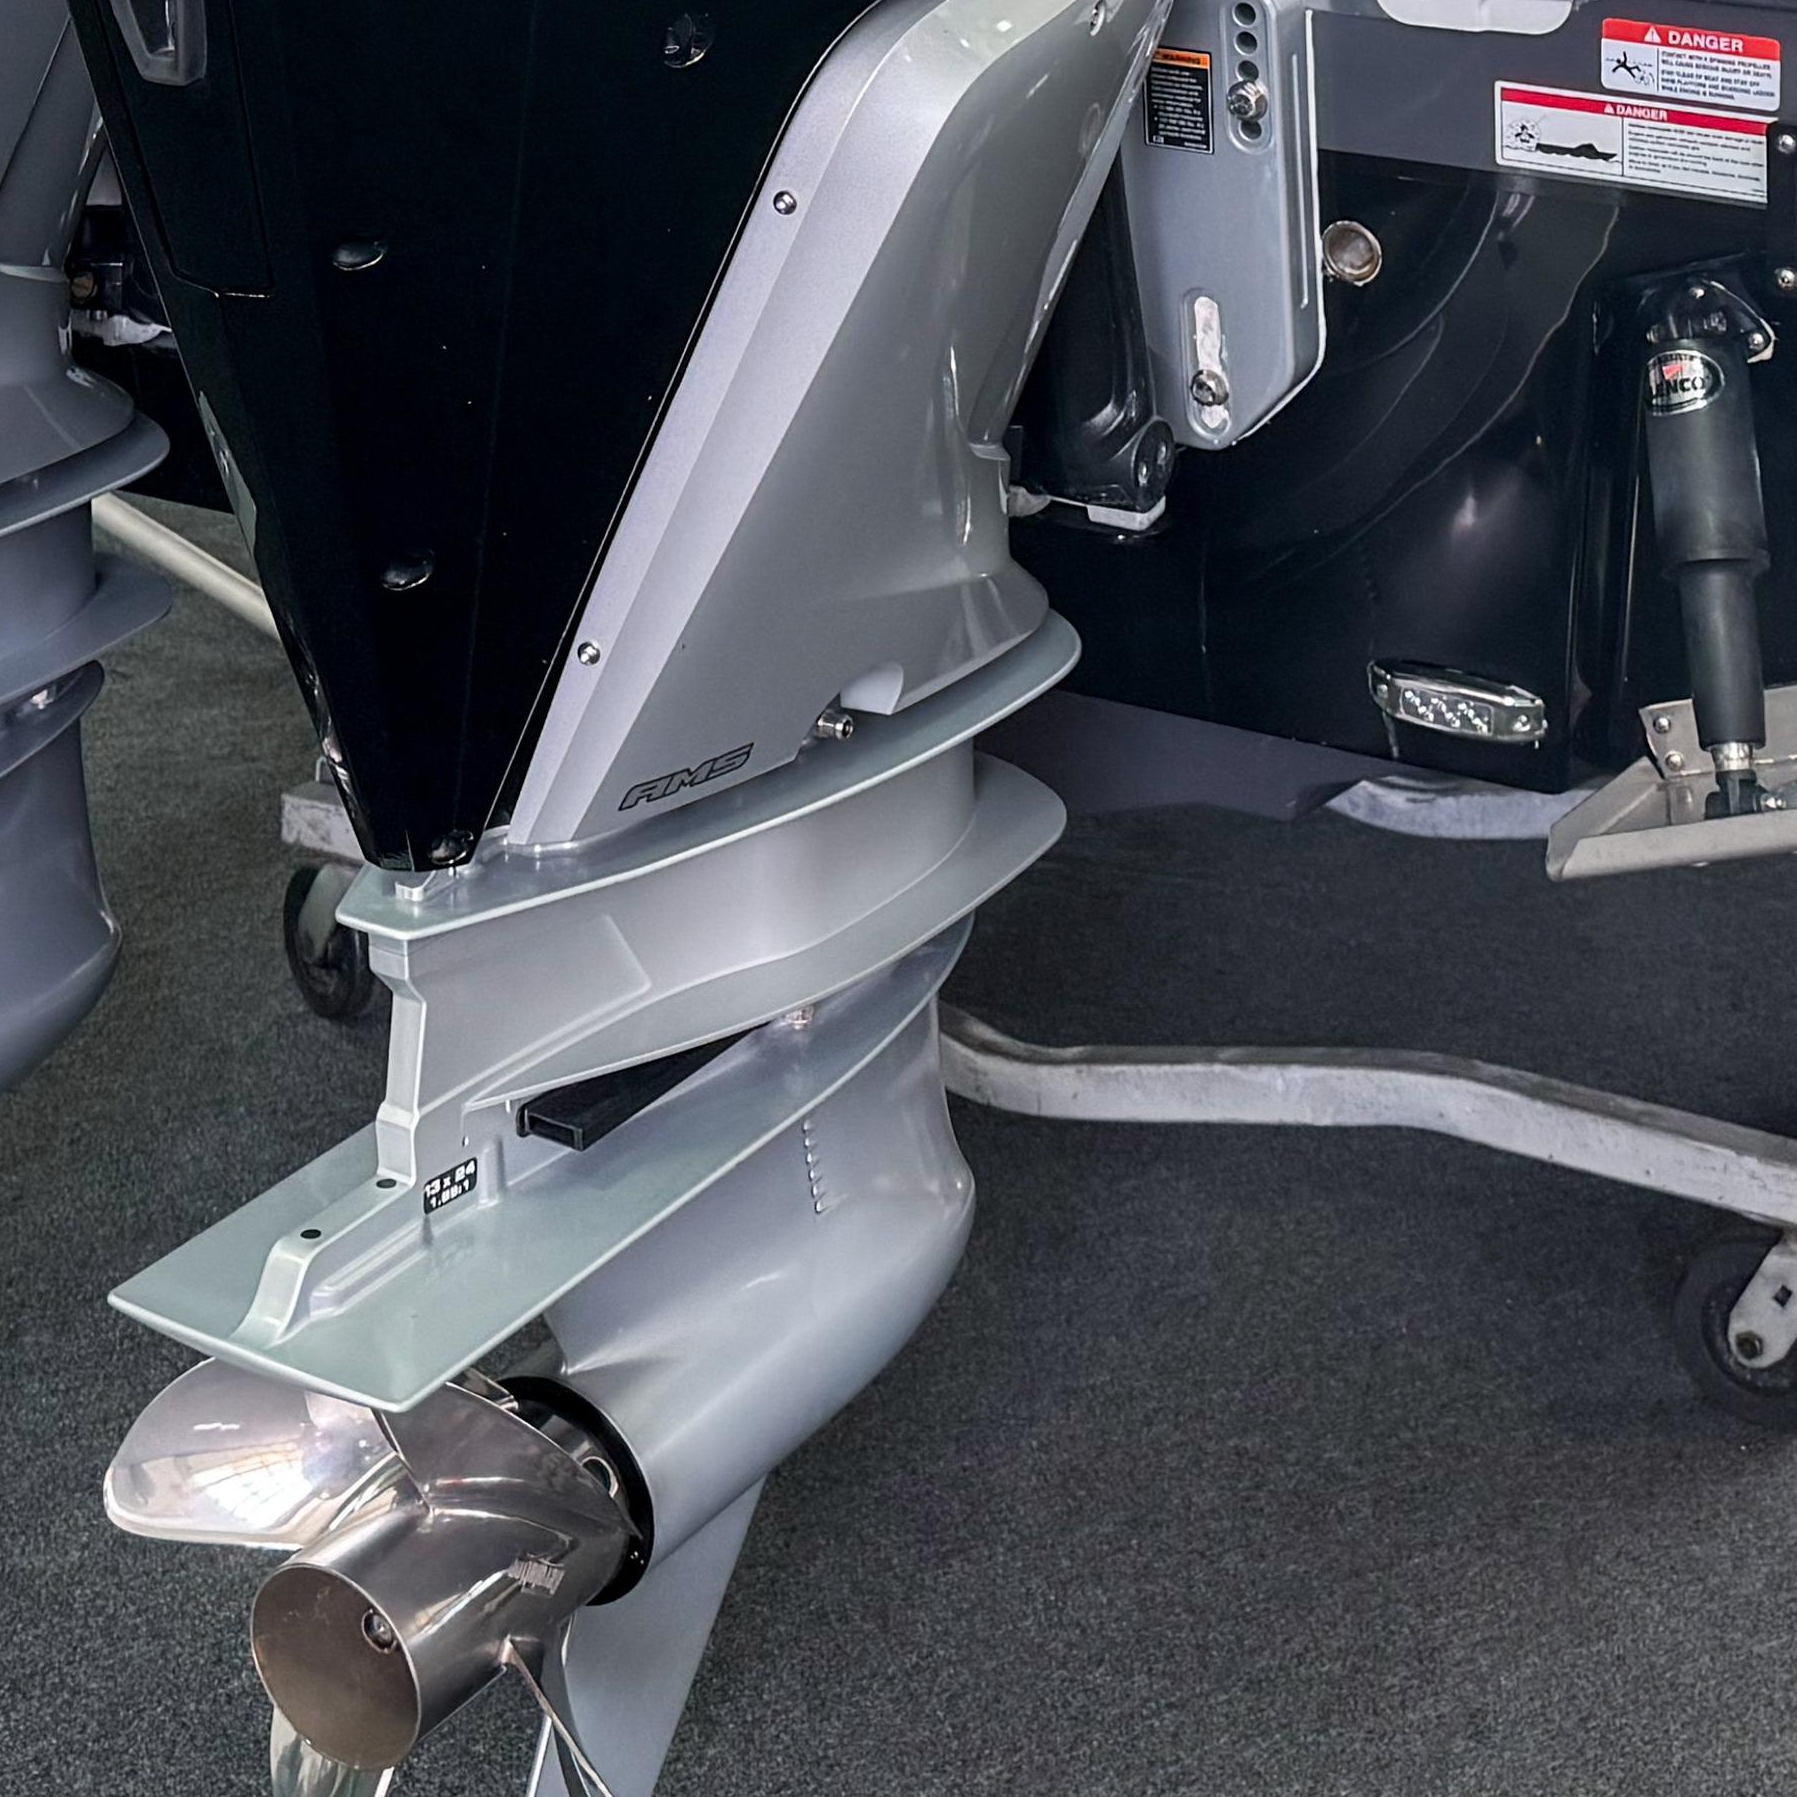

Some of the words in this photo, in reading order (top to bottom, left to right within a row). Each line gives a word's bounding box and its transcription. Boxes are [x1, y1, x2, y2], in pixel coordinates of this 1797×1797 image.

[1668, 30, 1744, 53] DANGER
[1616, 104, 1668, 121] DANGER
[618, 742, 754, 812] AMS
